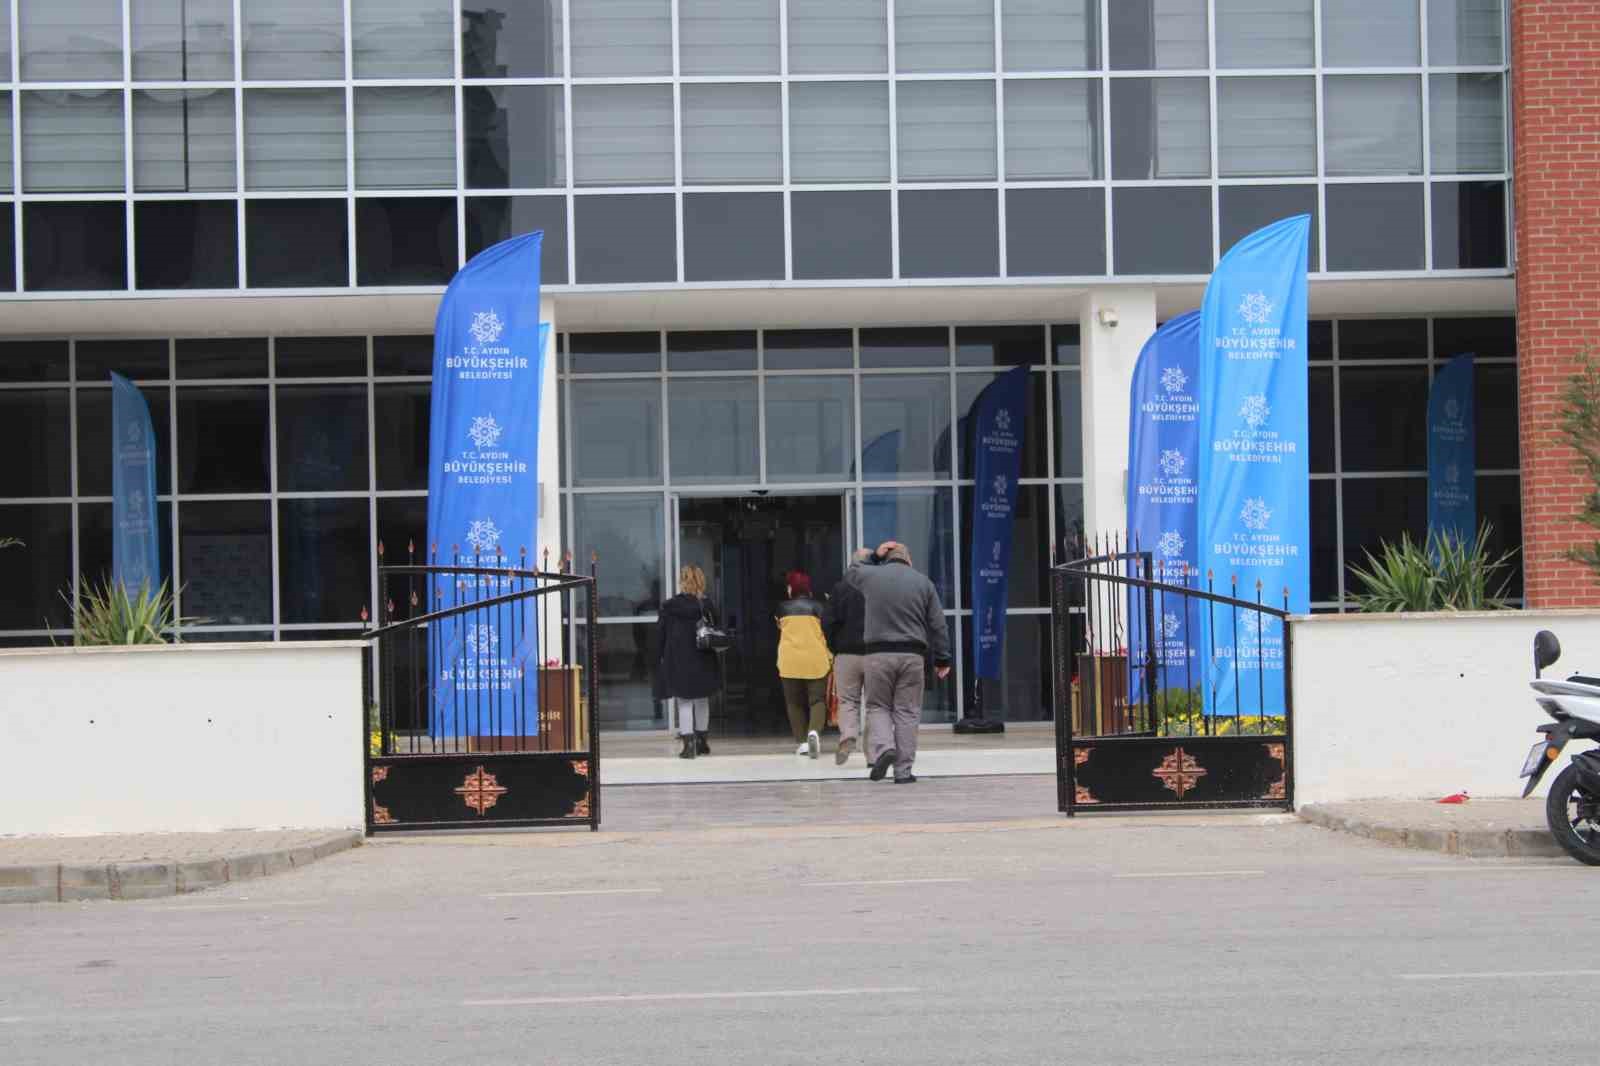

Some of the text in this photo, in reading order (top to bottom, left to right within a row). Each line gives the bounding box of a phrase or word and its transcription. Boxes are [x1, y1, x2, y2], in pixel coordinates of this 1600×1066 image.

[481, 347, 510, 355] AYDIN
[446, 356, 528, 370] BÜYÜKŞEHİR
[459, 371, 512, 380] BELEDİYESİ
[1214, 439, 1296, 455] BÜYÜKŞEHİR
[480, 452, 509, 460] AYDIN
[444, 460, 528, 475] BÜYÜKŞEHİR
[458, 475, 512, 484] BELEDİYESİ
[1214, 543, 1299, 557] BÜYÜKŞEHİR
[479, 555, 508, 563] AYDN
